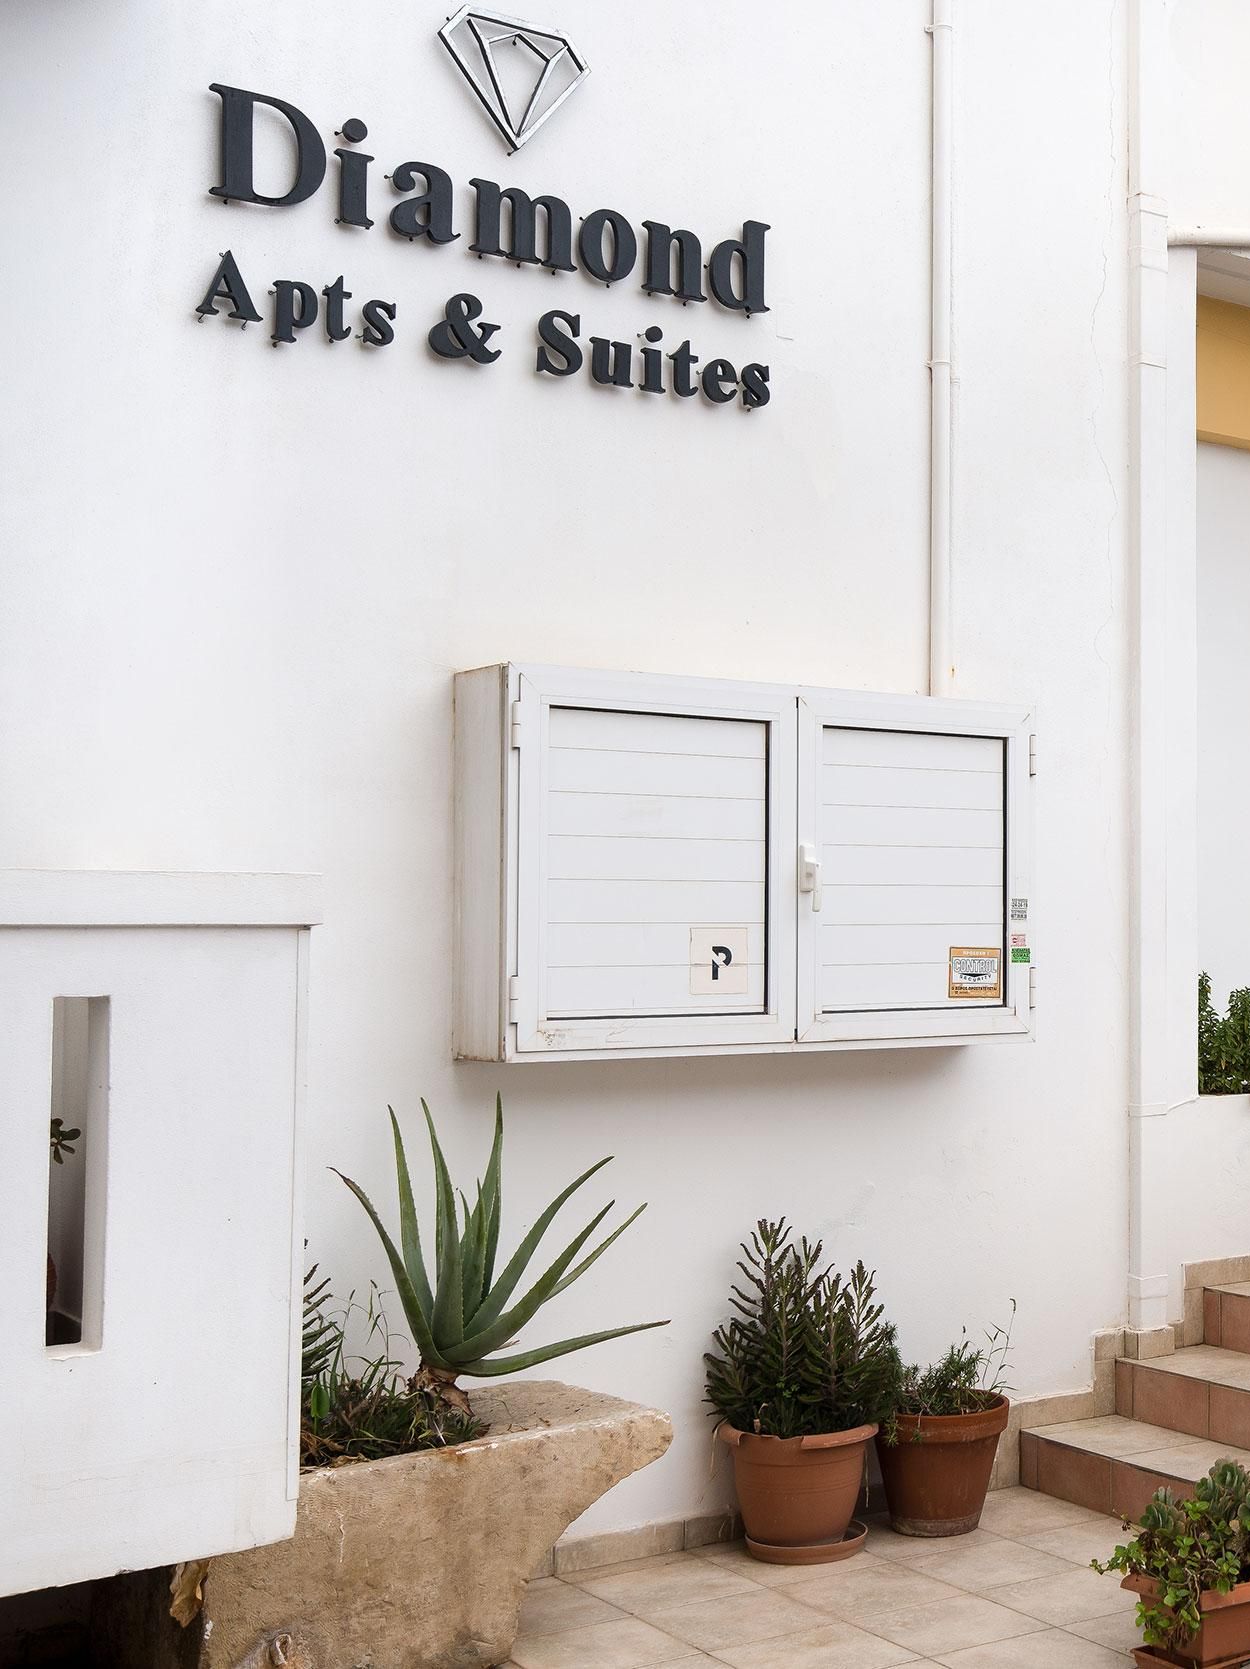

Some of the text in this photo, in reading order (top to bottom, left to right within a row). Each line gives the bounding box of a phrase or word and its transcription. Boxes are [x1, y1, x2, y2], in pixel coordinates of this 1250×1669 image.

[208, 83, 772, 315] Diamond
[196, 250, 770, 409] Apts & Suites
[954, 958, 997, 973] CONTROL
[959, 974, 992, 983] SECURITY
